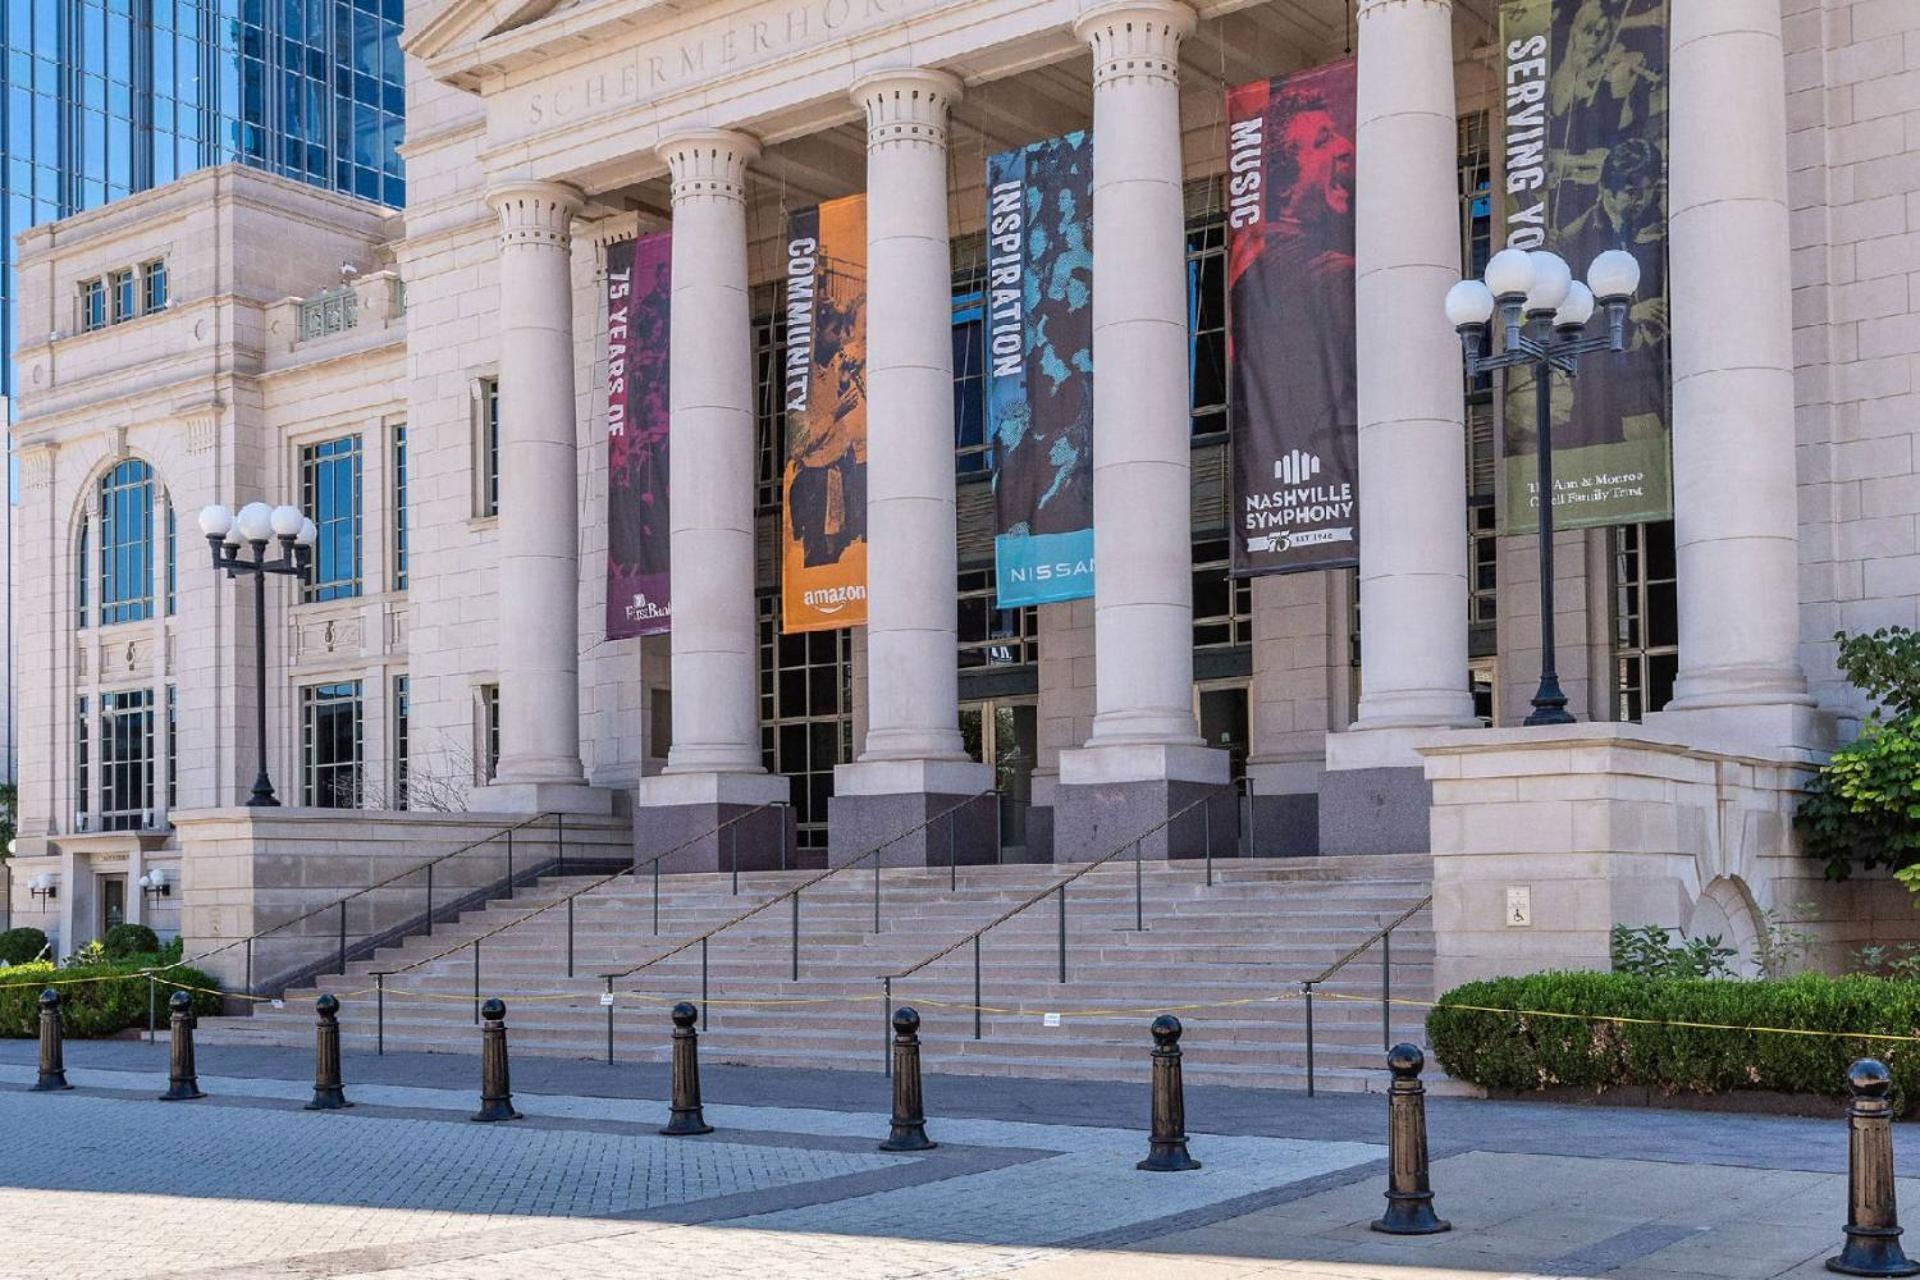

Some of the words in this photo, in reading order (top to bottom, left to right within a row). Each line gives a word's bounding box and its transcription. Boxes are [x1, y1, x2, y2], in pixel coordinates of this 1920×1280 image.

[1506, 35, 1547, 194] SERVING
[1230, 117, 1262, 229] MUSIC
[1507, 201, 1546, 251] YO
[609, 267, 630, 300] 75
[991, 180, 1022, 377] INSPIRATION
[786, 237, 816, 412] COMMUNITY
[607, 305, 628, 396] YEARS
[608, 404, 624, 436] OF
[1246, 483, 1352, 512] NASHVILLE
[1530, 493, 1565, 508] Cell
[1613, 486, 1644, 499] Trust
[1553, 479, 1578, 491] Ann
[1581, 477, 1593, 487] &
[1595, 472, 1644, 485] Monroe
[1246, 501, 1354, 530] SYMPHONY
[1268, 530, 1290, 553] 75
[803, 585, 866, 605] amazon
